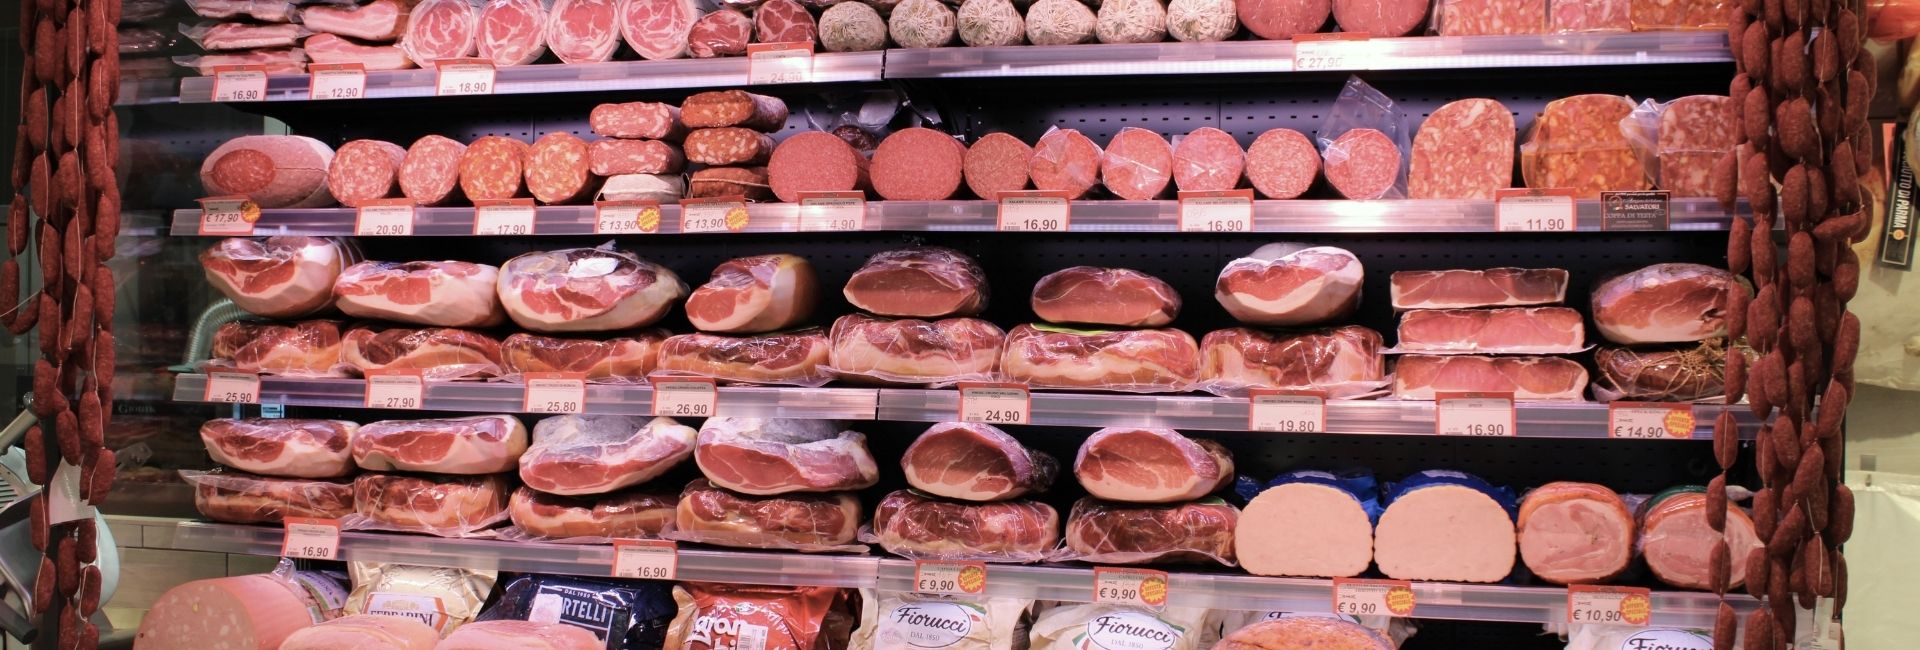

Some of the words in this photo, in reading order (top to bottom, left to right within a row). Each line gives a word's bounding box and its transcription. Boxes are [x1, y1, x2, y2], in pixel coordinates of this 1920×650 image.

[331, 88, 358, 99] 12,90
[459, 82, 486, 94] 18,90
[232, 90, 258, 101] 16,90
[1897, 188, 1911, 200] DI
[206, 214, 211, 223] €
[215, 213, 239, 224] 17,90
[1893, 199, 1910, 229] PARMA
[376, 224, 404, 236] 20,90
[599, 221, 606, 230] €
[609, 220, 637, 232] 13,90
[685, 220, 692, 229] €
[695, 218, 724, 230] 13,90
[1024, 219, 1058, 231] 16,90
[1208, 220, 1243, 232] 16,90
[1527, 218, 1565, 231] 11,90
[226, 391, 252, 404] 25,90
[387, 397, 414, 409] 27,90
[547, 401, 576, 413] 25,80
[676, 403, 708, 417] 26,90
[985, 409, 1020, 423] 24,90
[1614, 426, 1622, 437] €
[1627, 426, 1664, 438] 14,90
[302, 545, 329, 557] 16,90
[637, 566, 667, 579] 16,90
[919, 579, 926, 590] €
[929, 579, 954, 592] 9,90
[564, 588, 577, 596] DAL
[577, 591, 591, 599] 1959
[1099, 588, 1107, 598] €
[1110, 588, 1136, 601] 9,90
[1338, 602, 1345, 612] €
[1349, 602, 1376, 614] 9,90
[896, 607, 967, 633] Fiorucci
[1573, 609, 1581, 620] €
[1585, 609, 1621, 622] 10,90
[1094, 616, 1172, 643] Fiorucci
[910, 631, 924, 640] DAL
[926, 633, 940, 641] 1850
